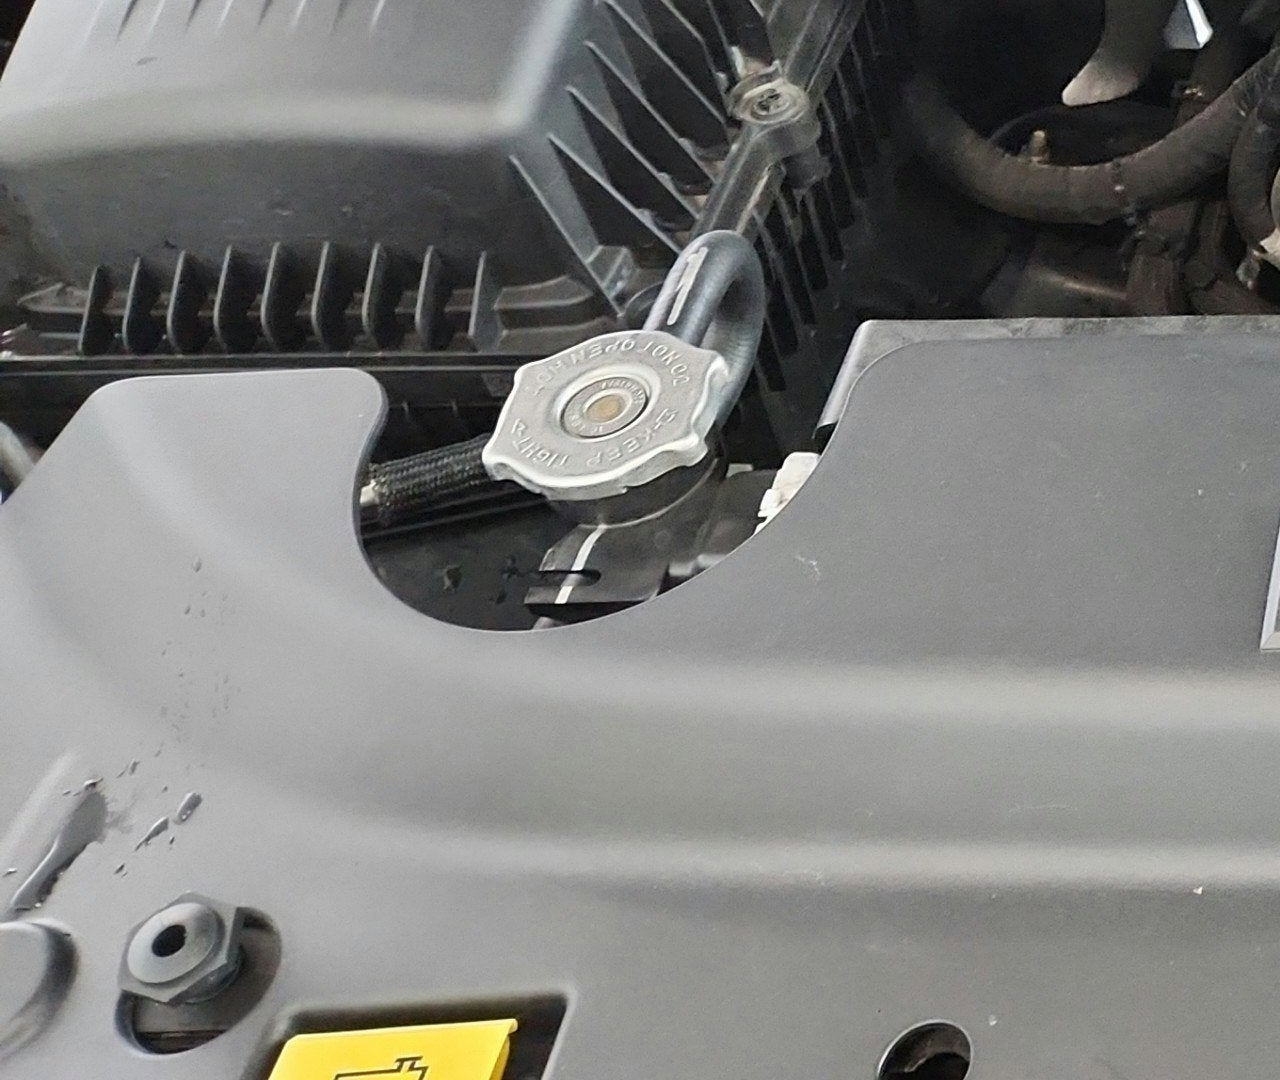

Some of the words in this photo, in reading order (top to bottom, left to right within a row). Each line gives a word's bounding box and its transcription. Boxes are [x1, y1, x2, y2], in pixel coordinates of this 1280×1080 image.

[572, 340, 635, 367] OPEN
[512, 437, 571, 469] TIGHT
[585, 429, 658, 468] KEEP
